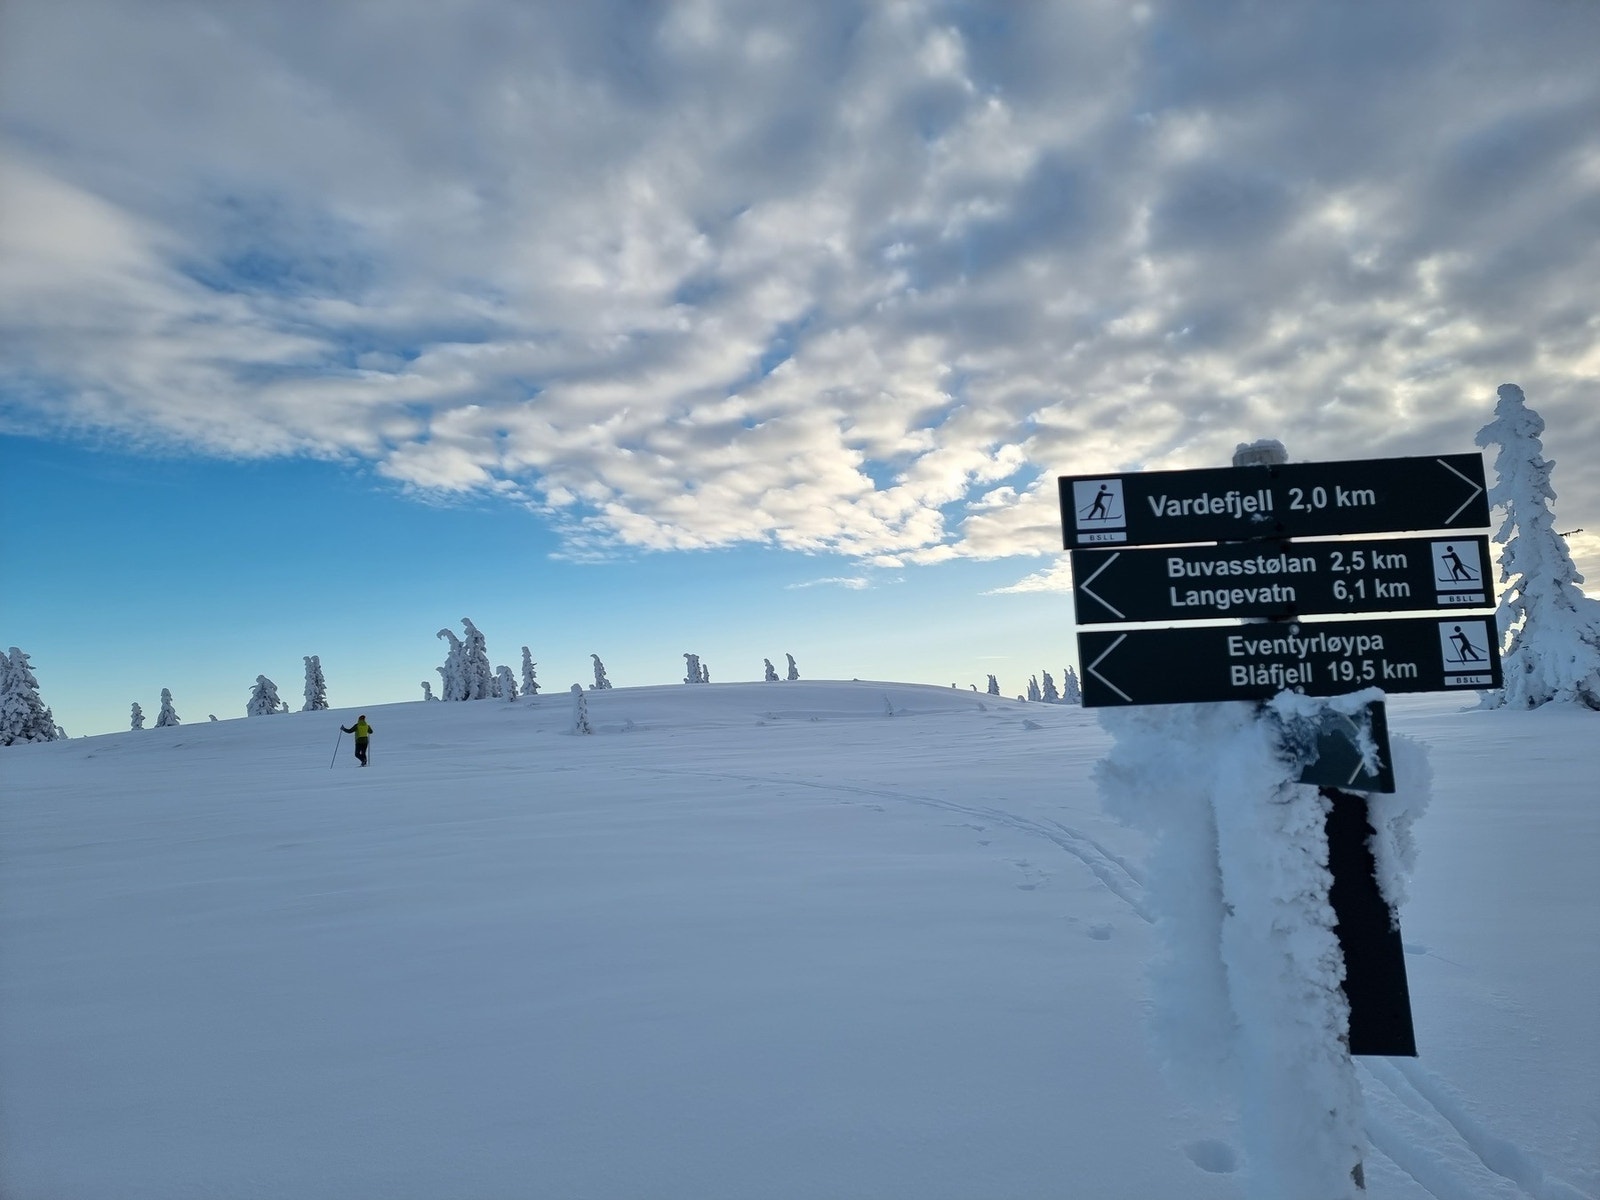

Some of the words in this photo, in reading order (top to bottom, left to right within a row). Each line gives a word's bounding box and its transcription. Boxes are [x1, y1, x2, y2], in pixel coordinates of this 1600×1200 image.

[1147, 489, 1273, 519] Vardefjell
[1288, 486, 1328, 513] 2,0
[1335, 485, 1376, 507] km
[1167, 554, 1316, 577] Buvasstølan
[1330, 551, 1366, 574] 2,5
[1371, 549, 1408, 570] km
[1170, 584, 1296, 609] Langevatn
[1333, 580, 1366, 602] 6,1
[1375, 578, 1411, 599] km
[1228, 633, 1384, 658] Eventyrløypa
[1230, 663, 1313, 690] Blåfjell
[1327, 660, 1376, 684] 19,5
[1382, 658, 1418, 680] km
